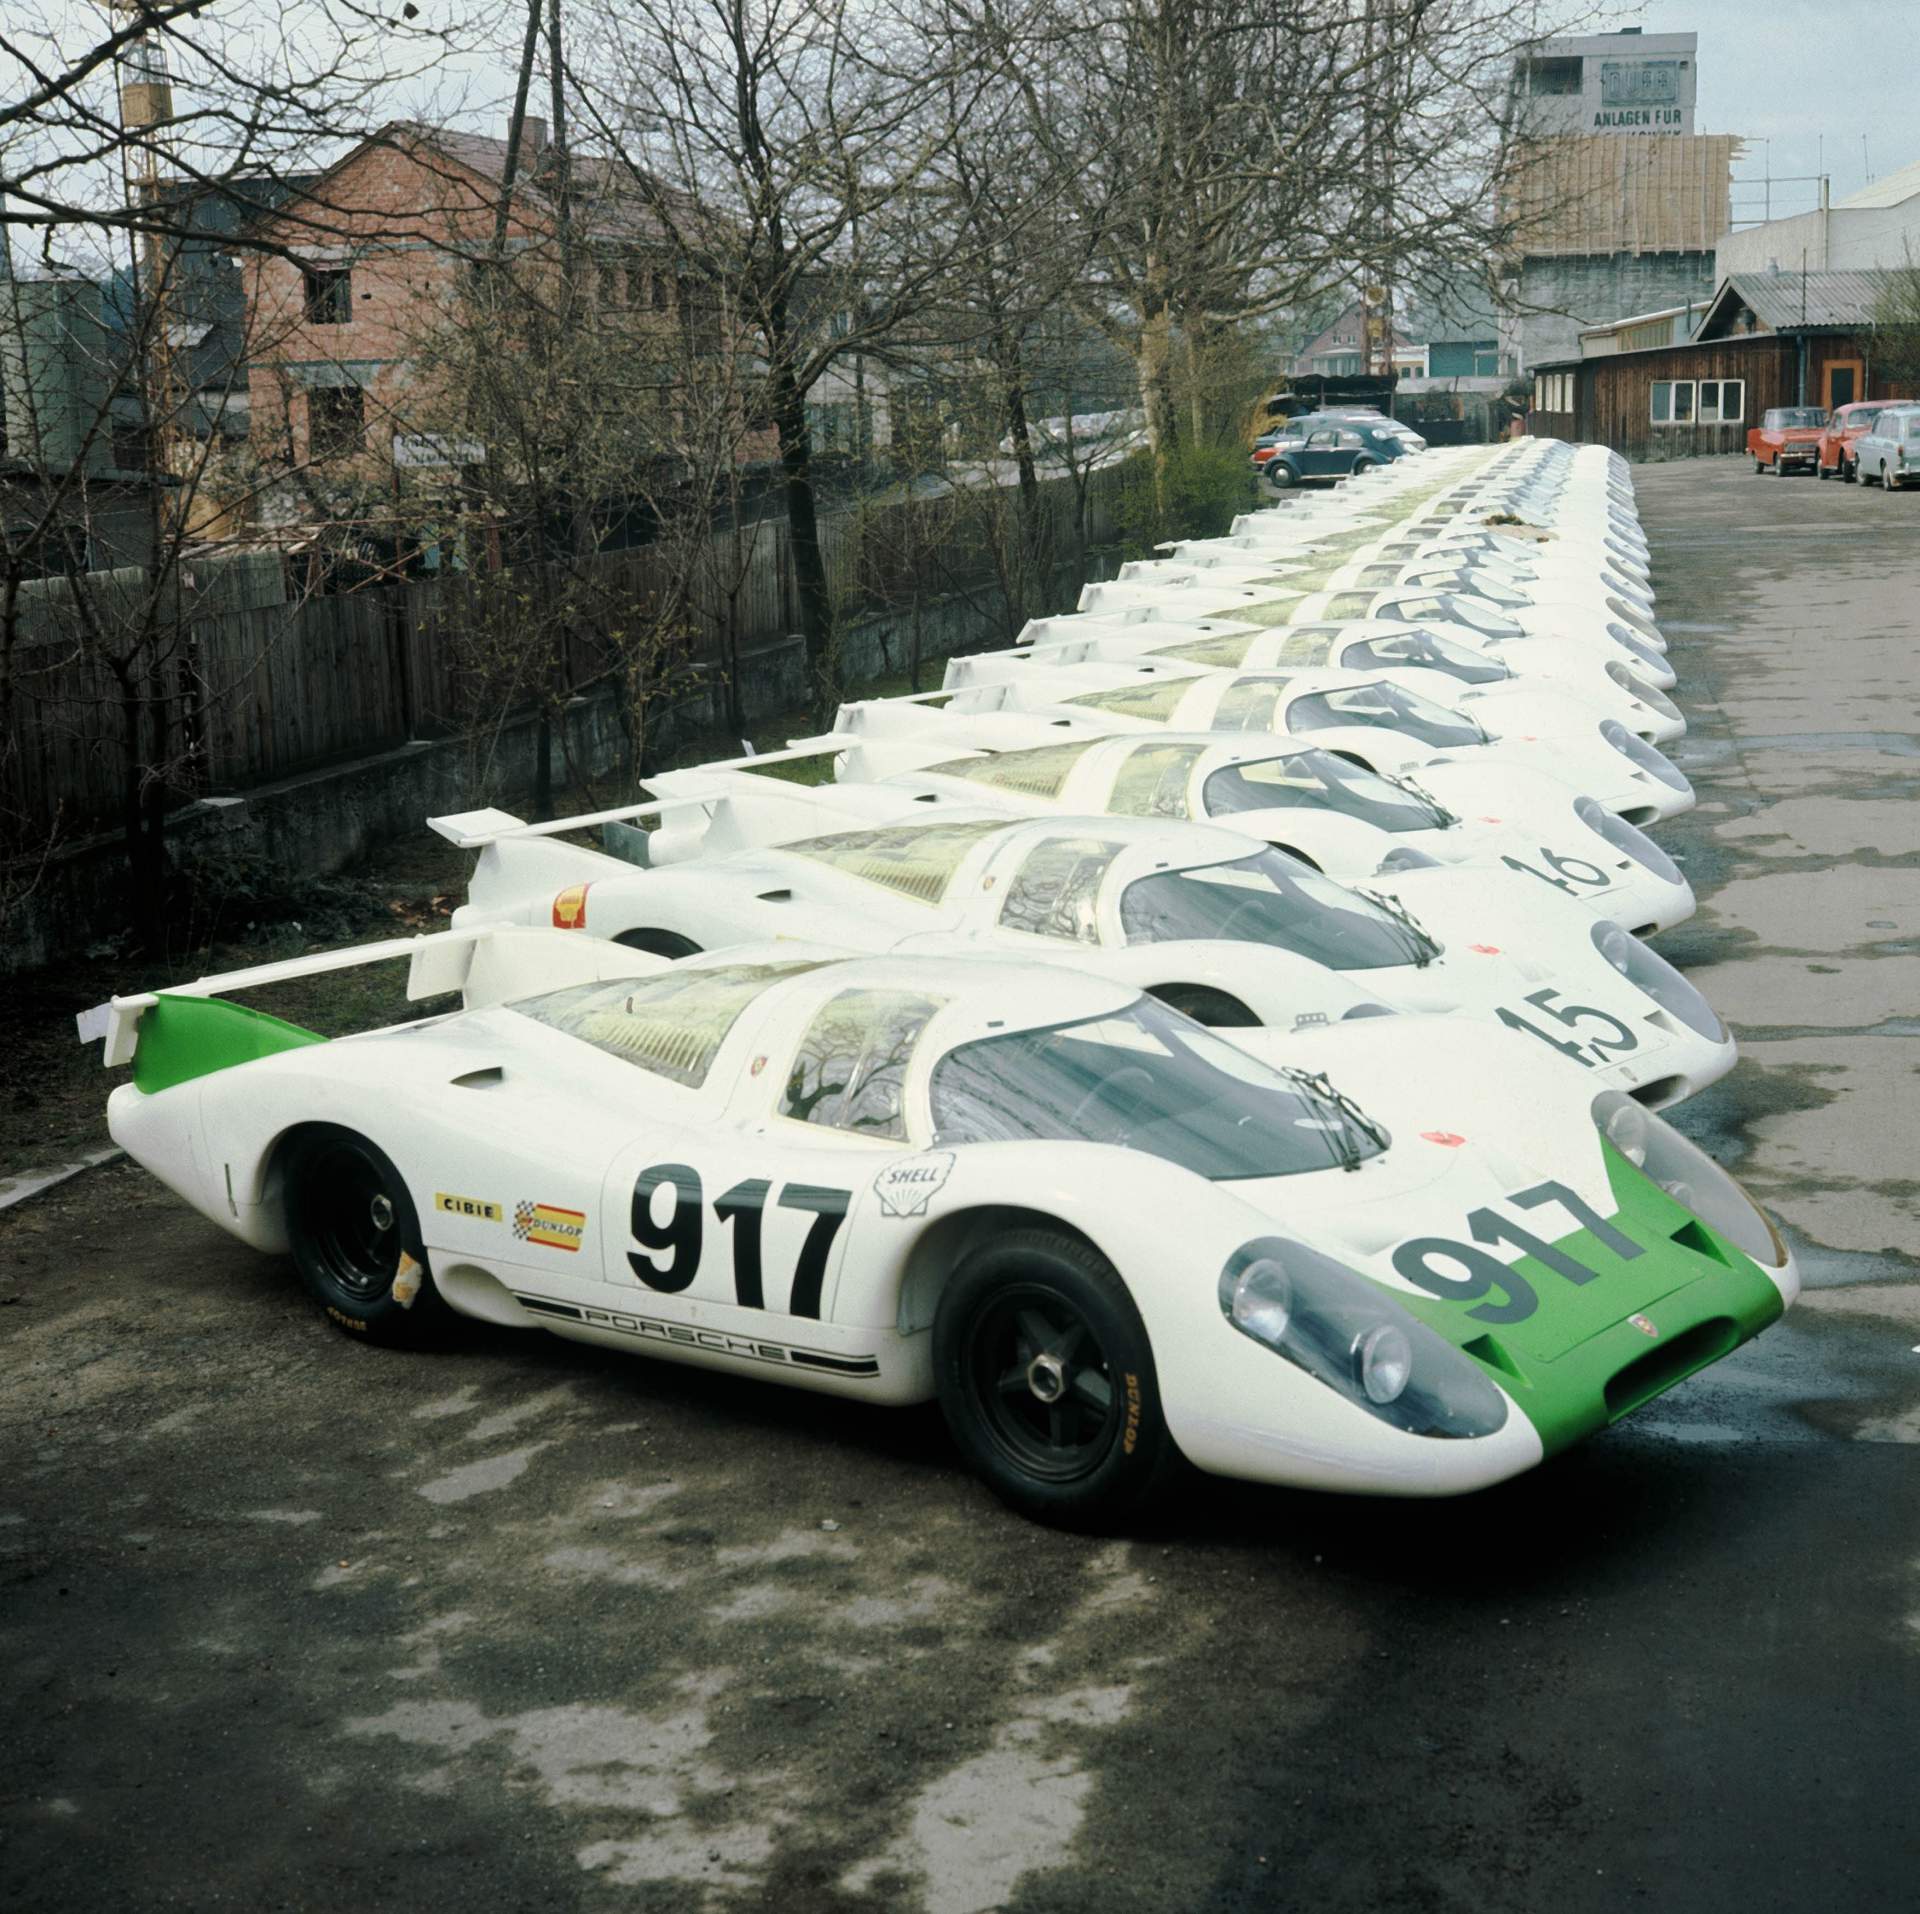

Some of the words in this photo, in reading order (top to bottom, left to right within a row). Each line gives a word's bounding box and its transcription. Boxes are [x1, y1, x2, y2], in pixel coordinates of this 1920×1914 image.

[1594, 110, 1650, 126] ANLAGEN
[1500, 847, 1611, 897] 16
[1494, 988, 1639, 1068] 15
[888, 1167, 938, 1184] SHELL
[443, 1198, 494, 1218] CIBIE
[532, 1218, 583, 1237] DUNLOP
[626, 1163, 853, 1321] 917
[1391, 1180, 1644, 1325] 917
[586, 1310, 787, 1361] PORSCHE
